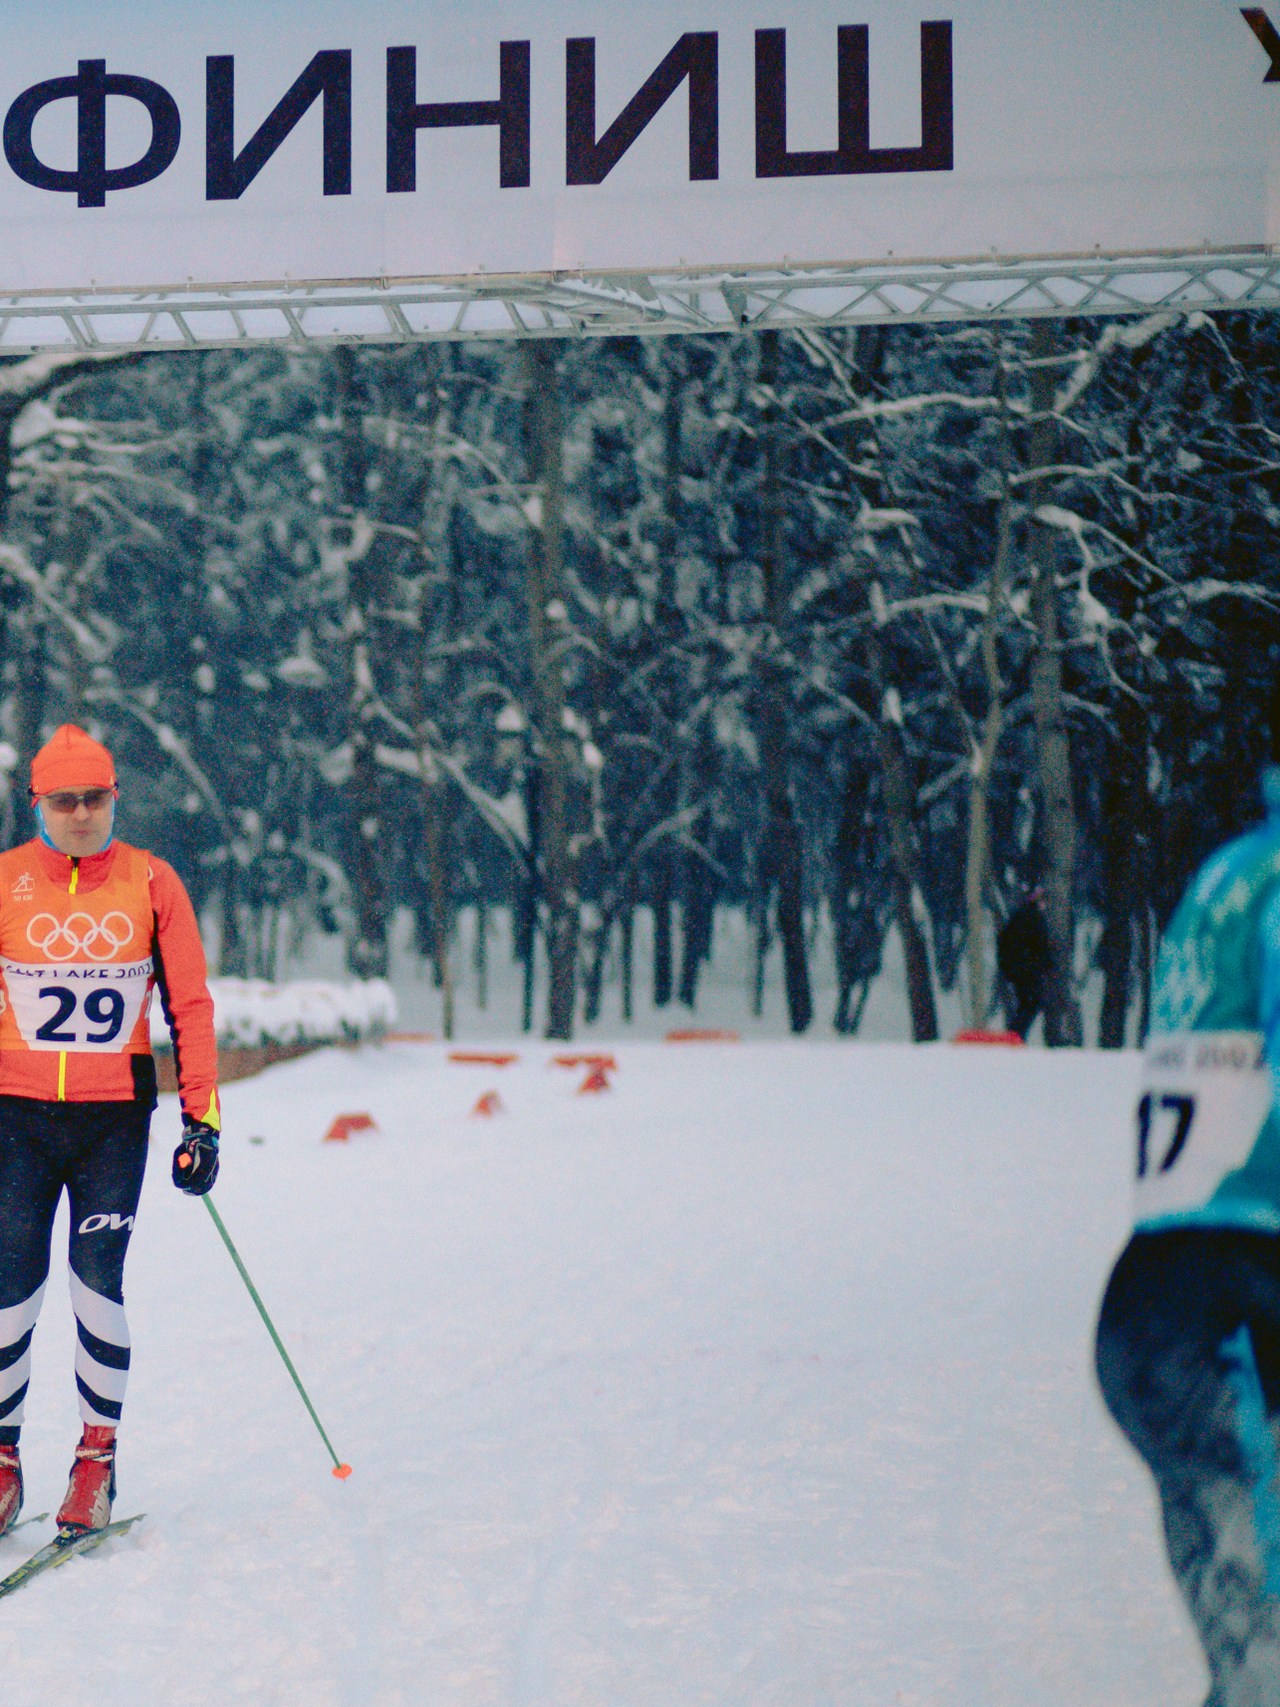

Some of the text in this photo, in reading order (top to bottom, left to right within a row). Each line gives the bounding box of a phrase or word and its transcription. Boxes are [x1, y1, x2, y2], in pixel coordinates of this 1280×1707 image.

[1, 18, 955, 208] ФИНИШ
[35, 985, 125, 1043] 29
[1137, 1092, 1196, 1178] 17
